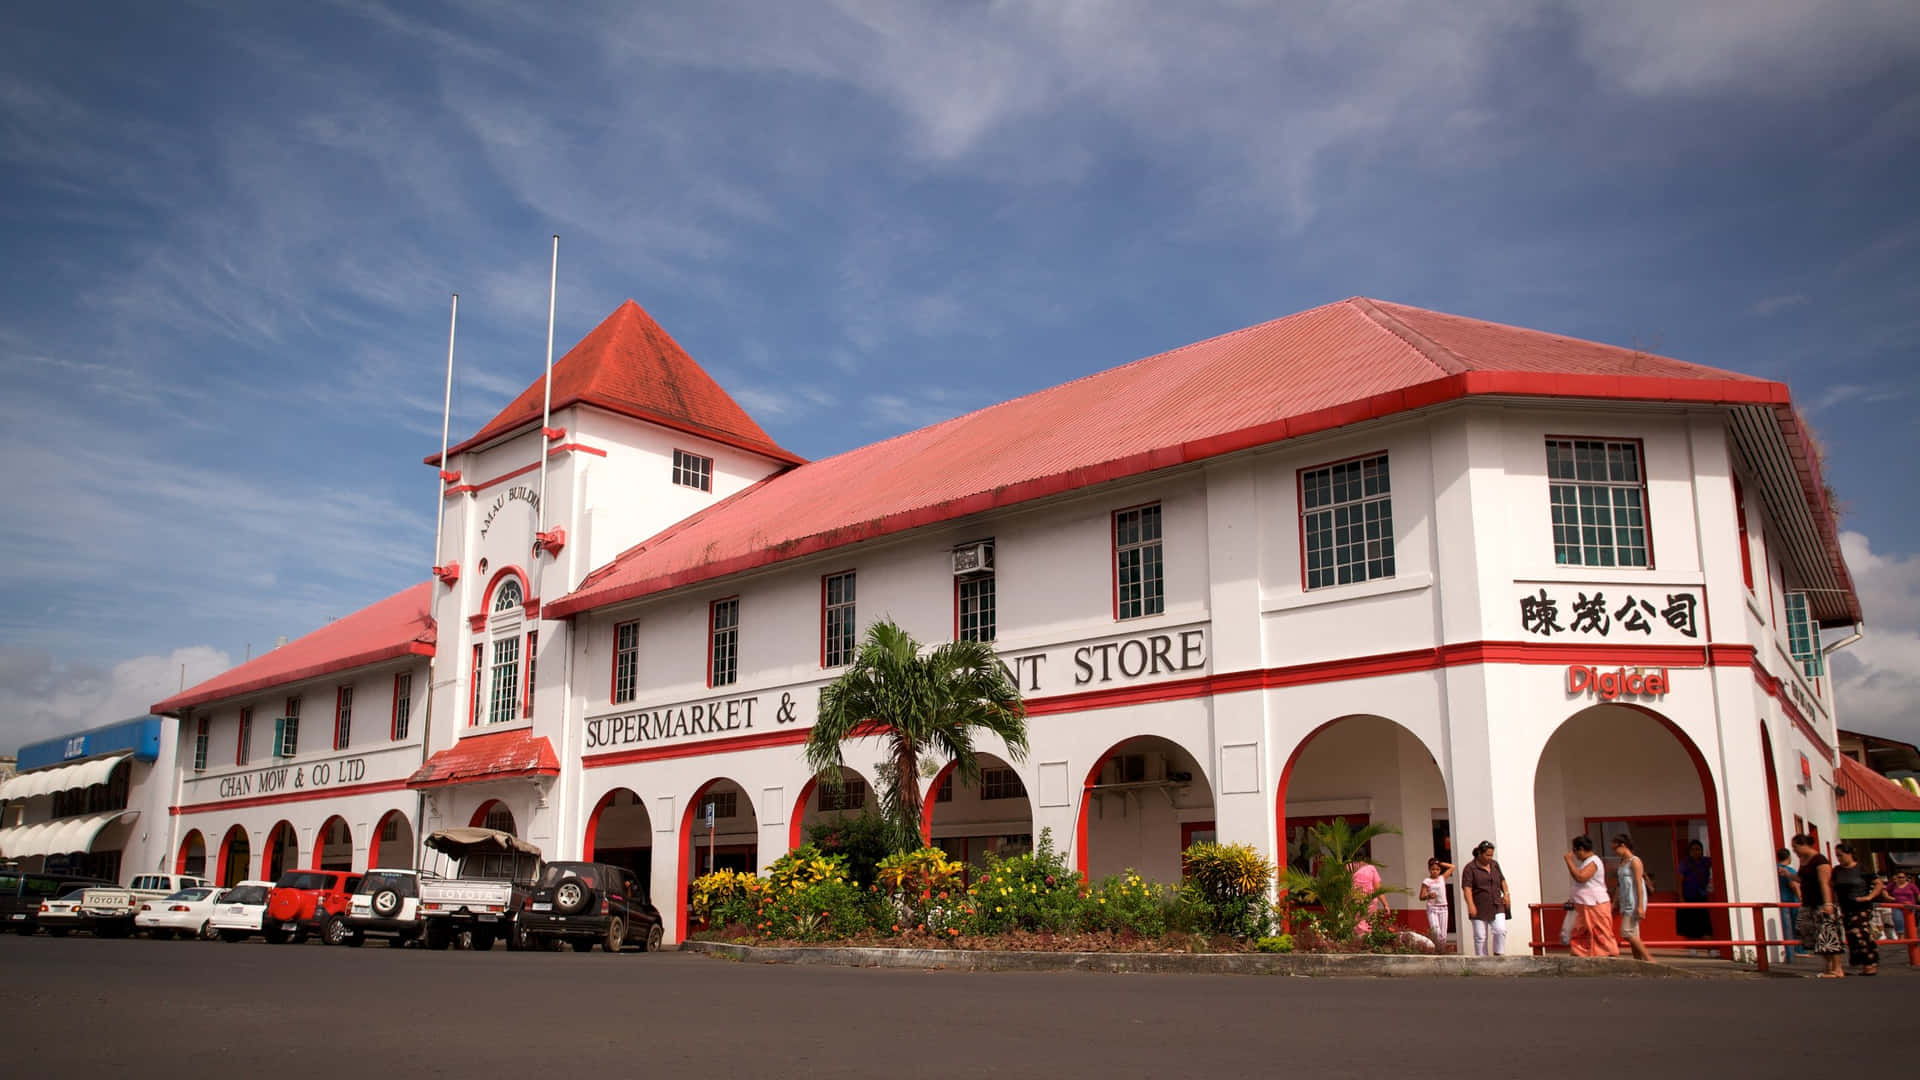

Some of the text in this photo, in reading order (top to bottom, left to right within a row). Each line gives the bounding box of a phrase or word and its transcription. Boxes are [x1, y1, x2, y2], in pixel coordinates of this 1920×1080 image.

[509, 486, 540, 512] BUILDIN
[1520, 588, 1698, 638] 陳茂公司
[586, 630, 1207, 748] SUPERMARKET & STORE
[1567, 664, 1670, 700] Digicel
[220, 758, 366, 798] CHAN MOW & CO LTD
[89, 896, 124, 904] TOYOTA
